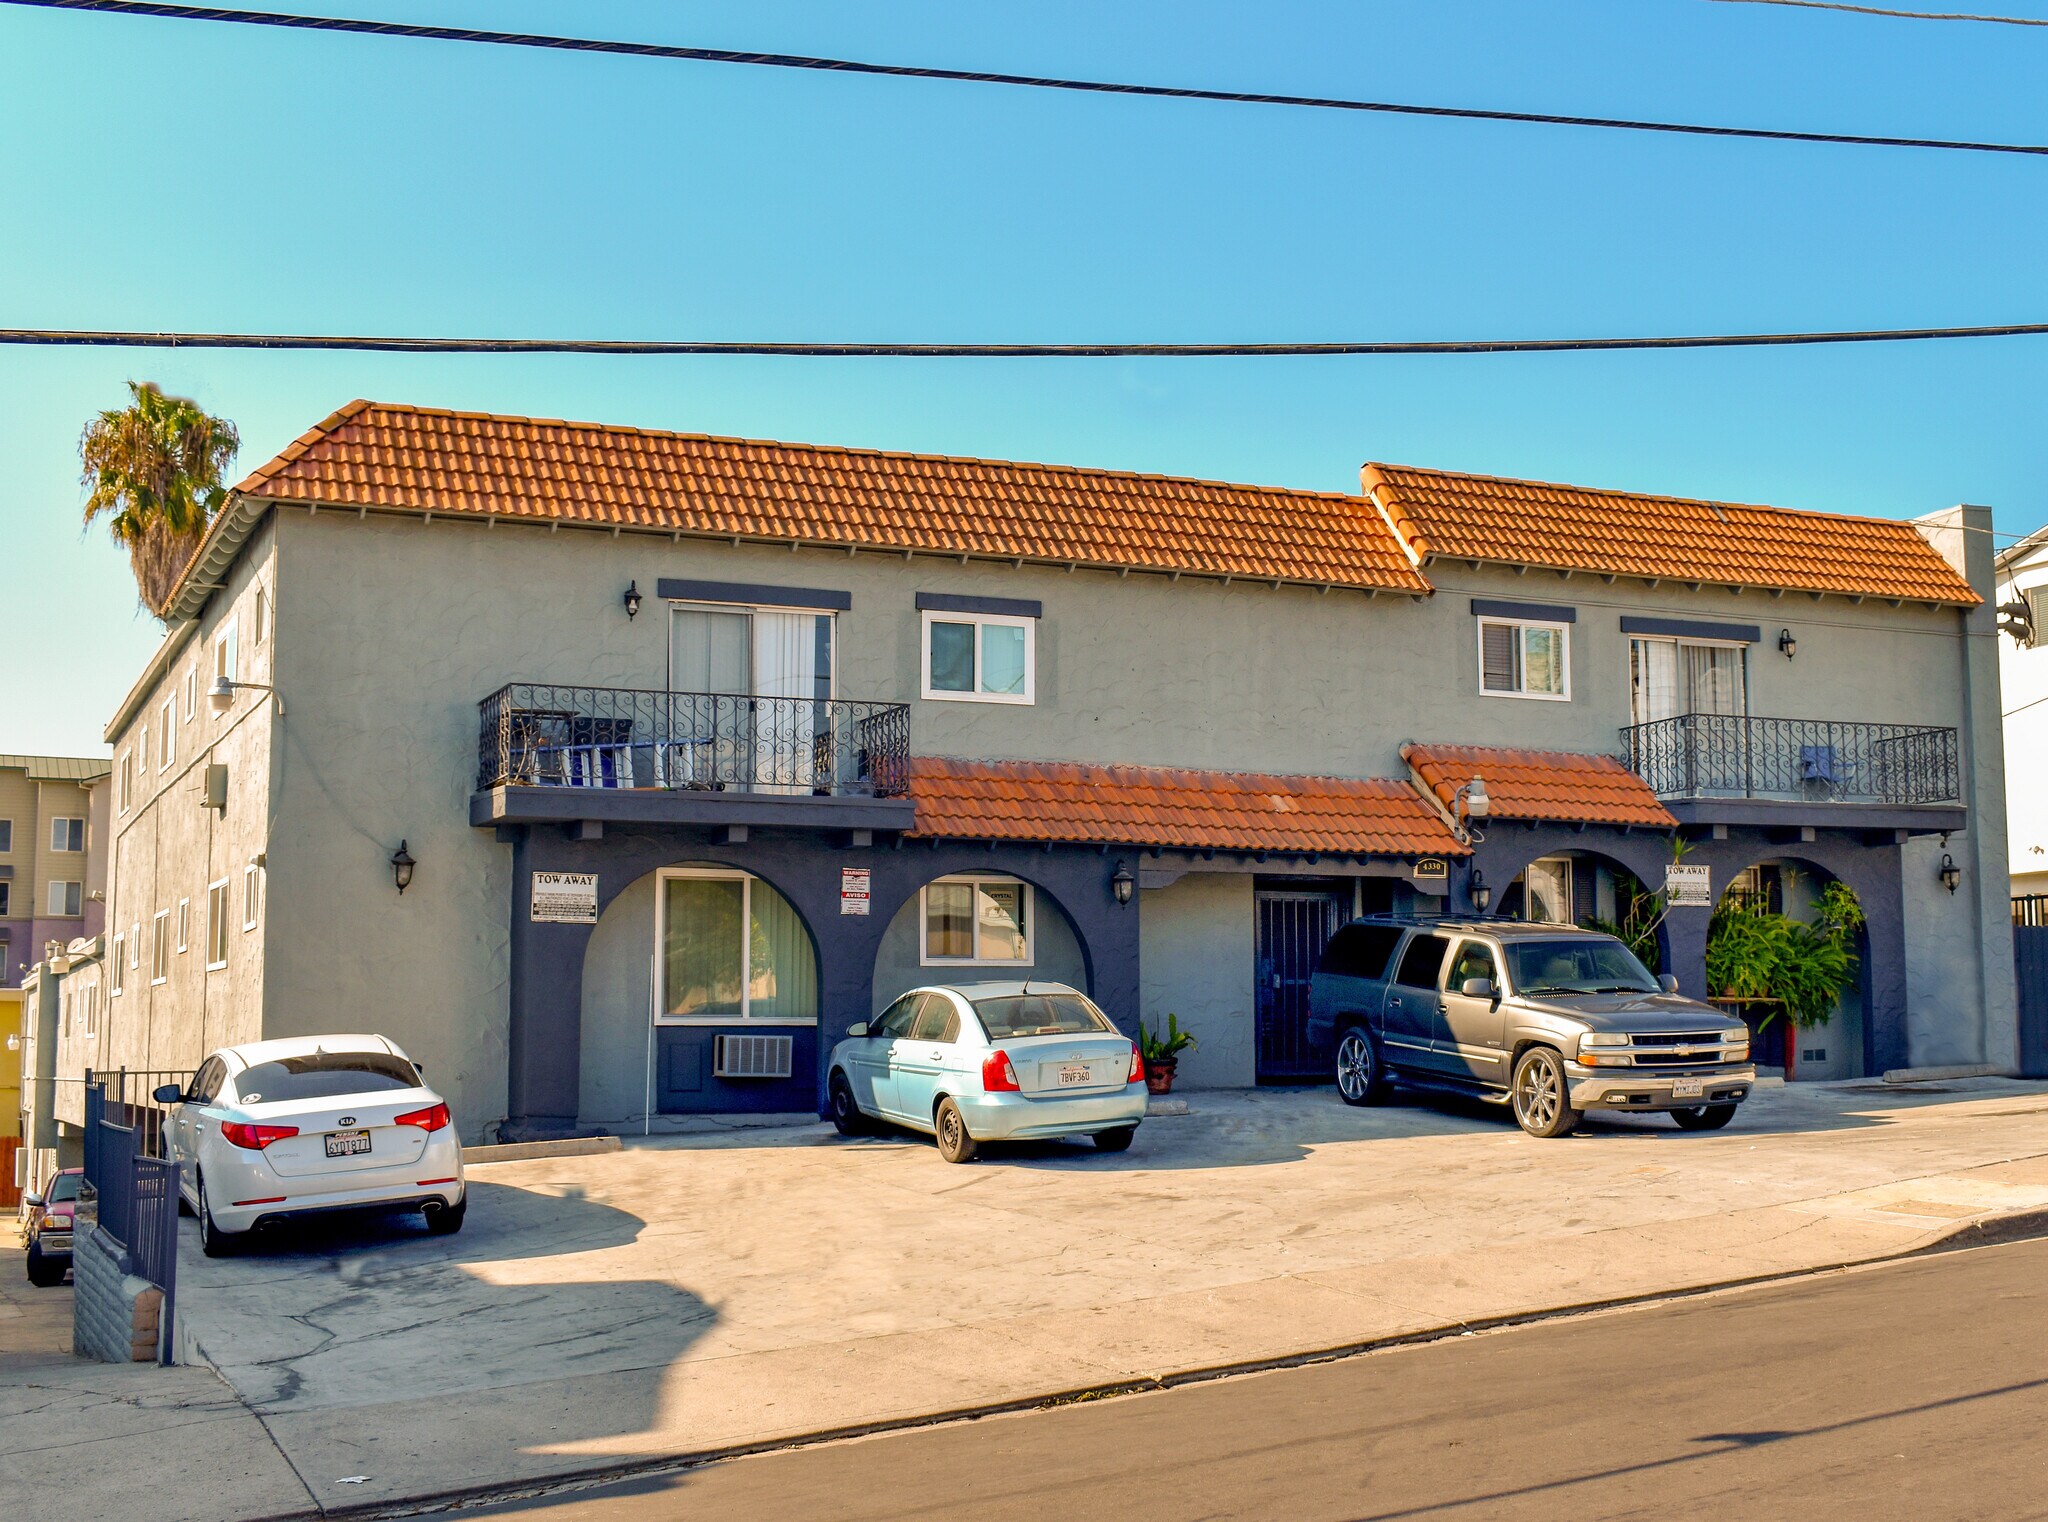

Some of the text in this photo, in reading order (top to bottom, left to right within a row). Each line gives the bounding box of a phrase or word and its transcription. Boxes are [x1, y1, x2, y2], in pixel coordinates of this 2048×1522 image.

[1687, 867, 1707, 875] AWAY
[537, 874, 593, 885] TOW AWAY
[1060, 1071, 1090, 1083] 7BVF360
[329, 1139, 368, 1153] 6YDT877
